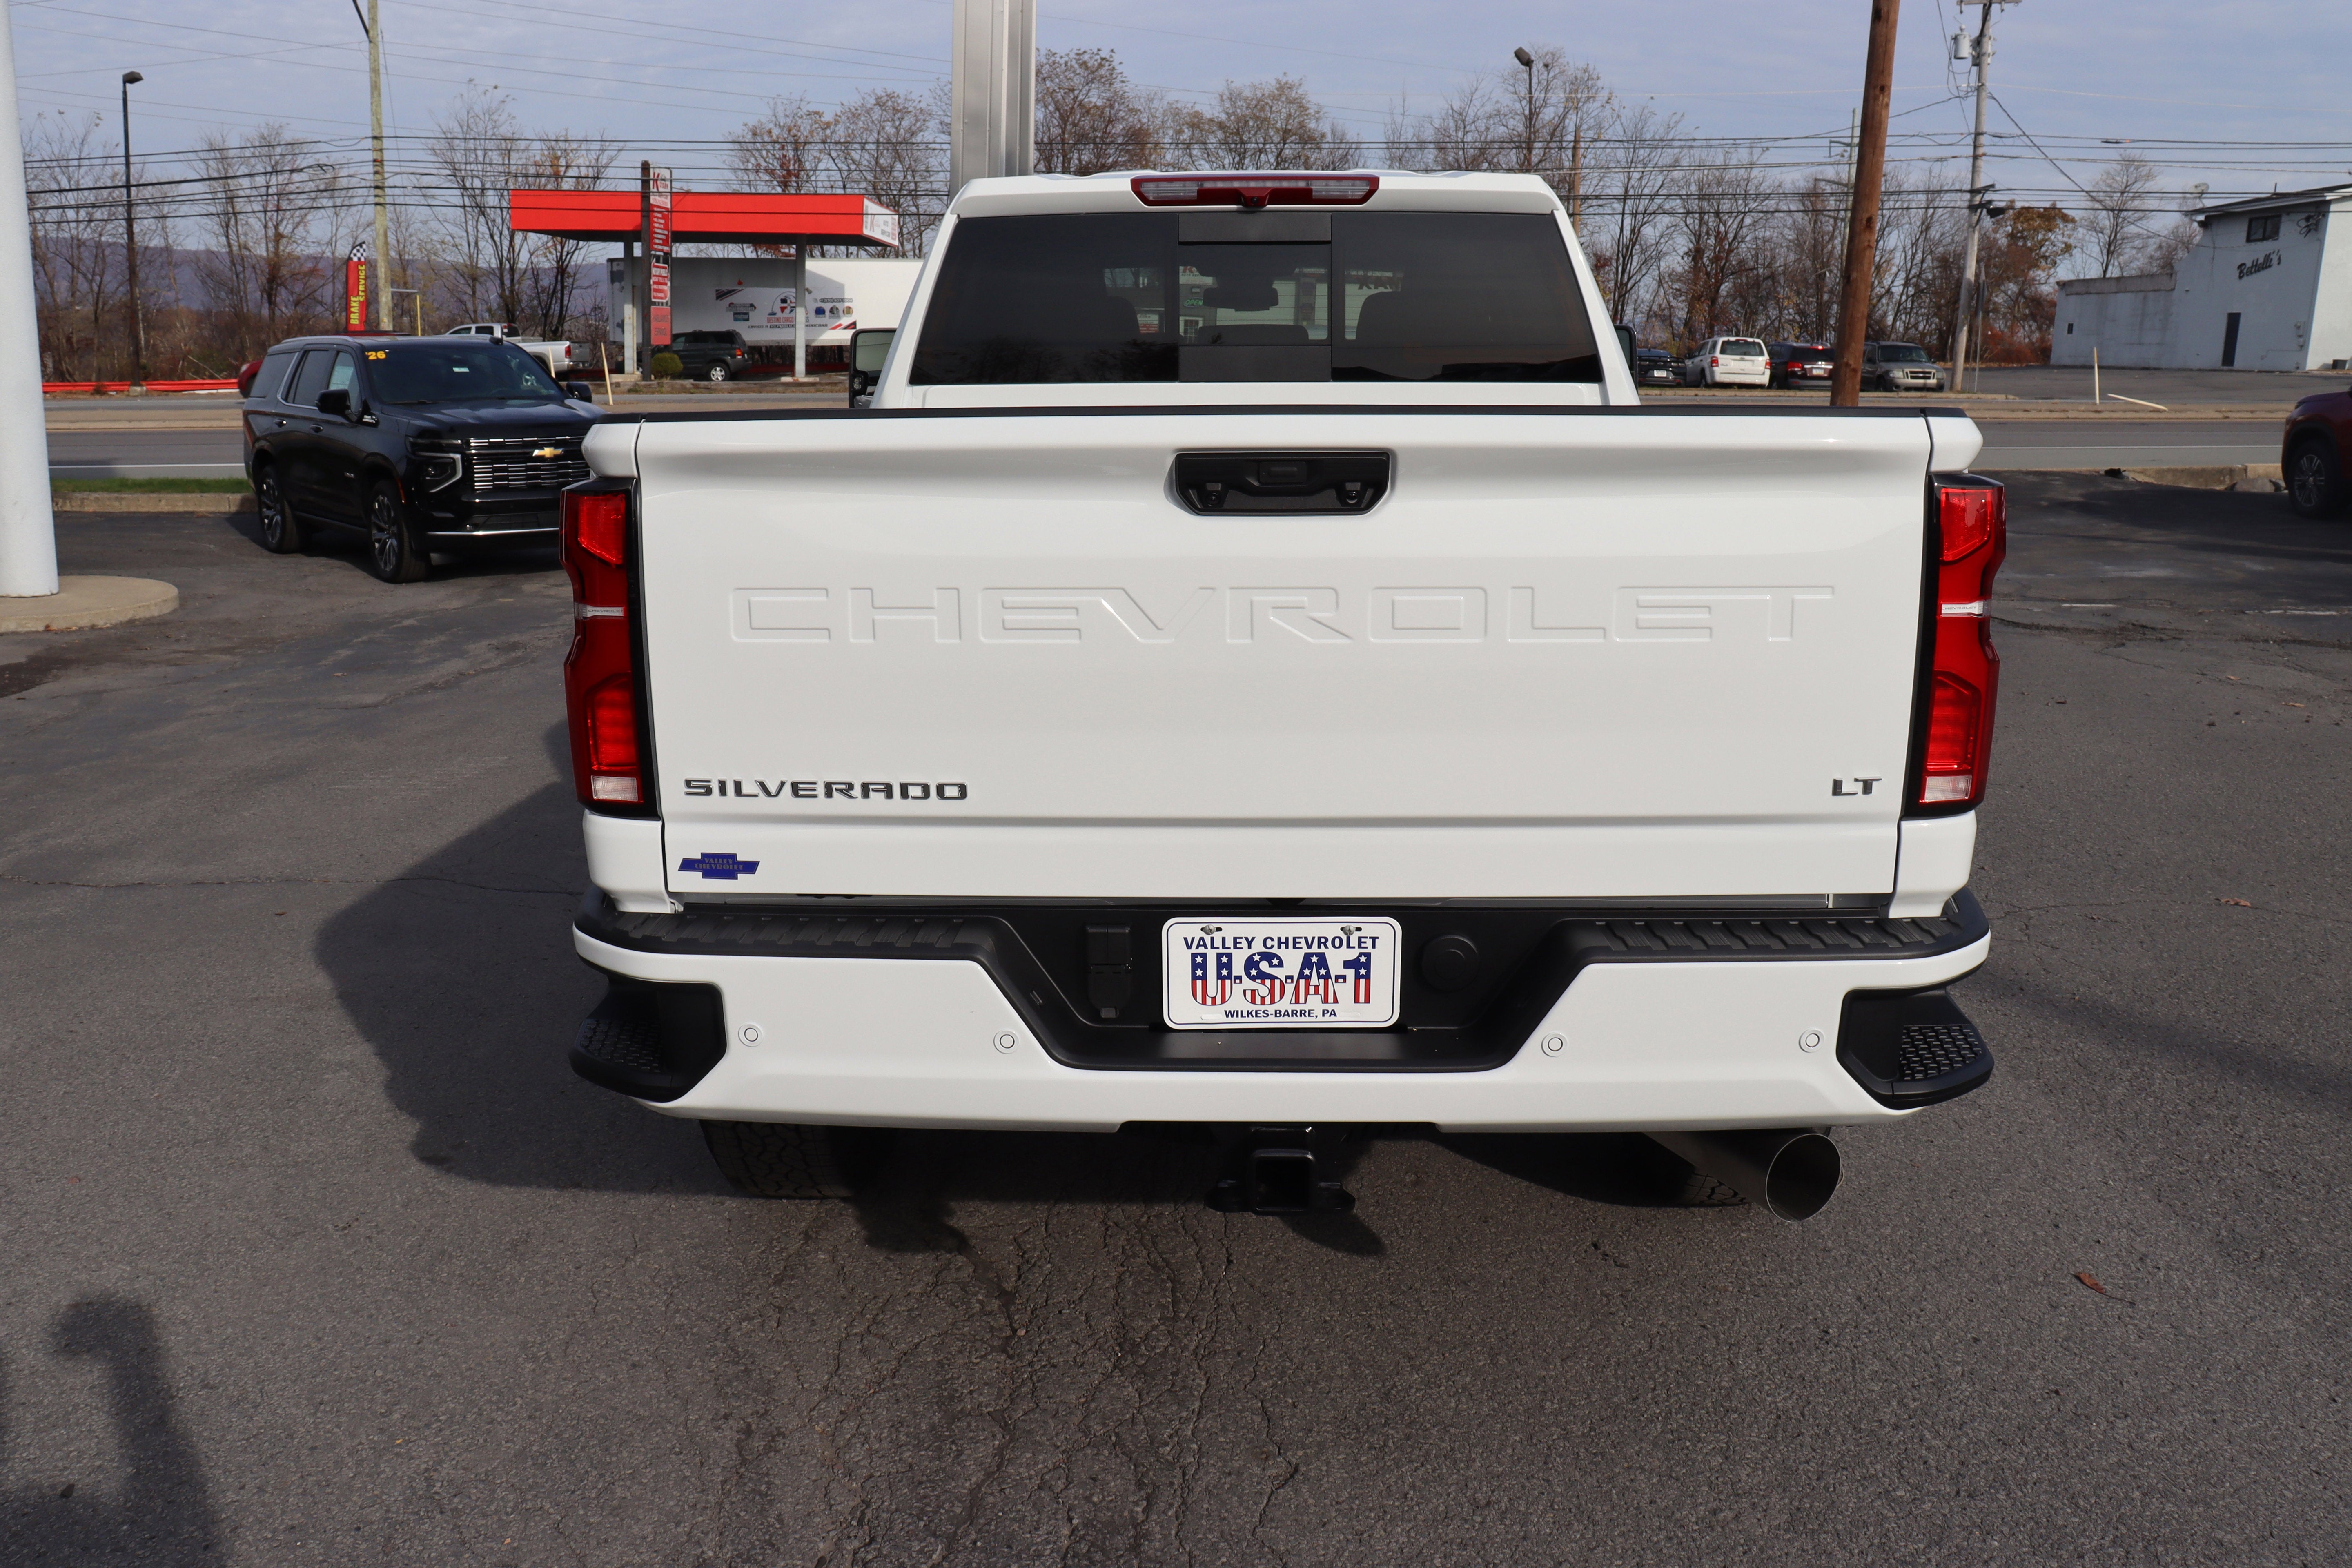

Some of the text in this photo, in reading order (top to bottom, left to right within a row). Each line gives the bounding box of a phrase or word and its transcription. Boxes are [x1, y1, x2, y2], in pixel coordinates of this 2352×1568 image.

[350, 295, 359, 325] BRAKE
[729, 586, 1835, 644] CHEVROLET
[684, 778, 968, 800] SILVERADO
[1832, 776, 1882, 796] LT
[1183, 936, 1380, 949] VALLEY CHEVROLET
[1223, 1009, 1338, 1019] WILKES-BARRE, PA
